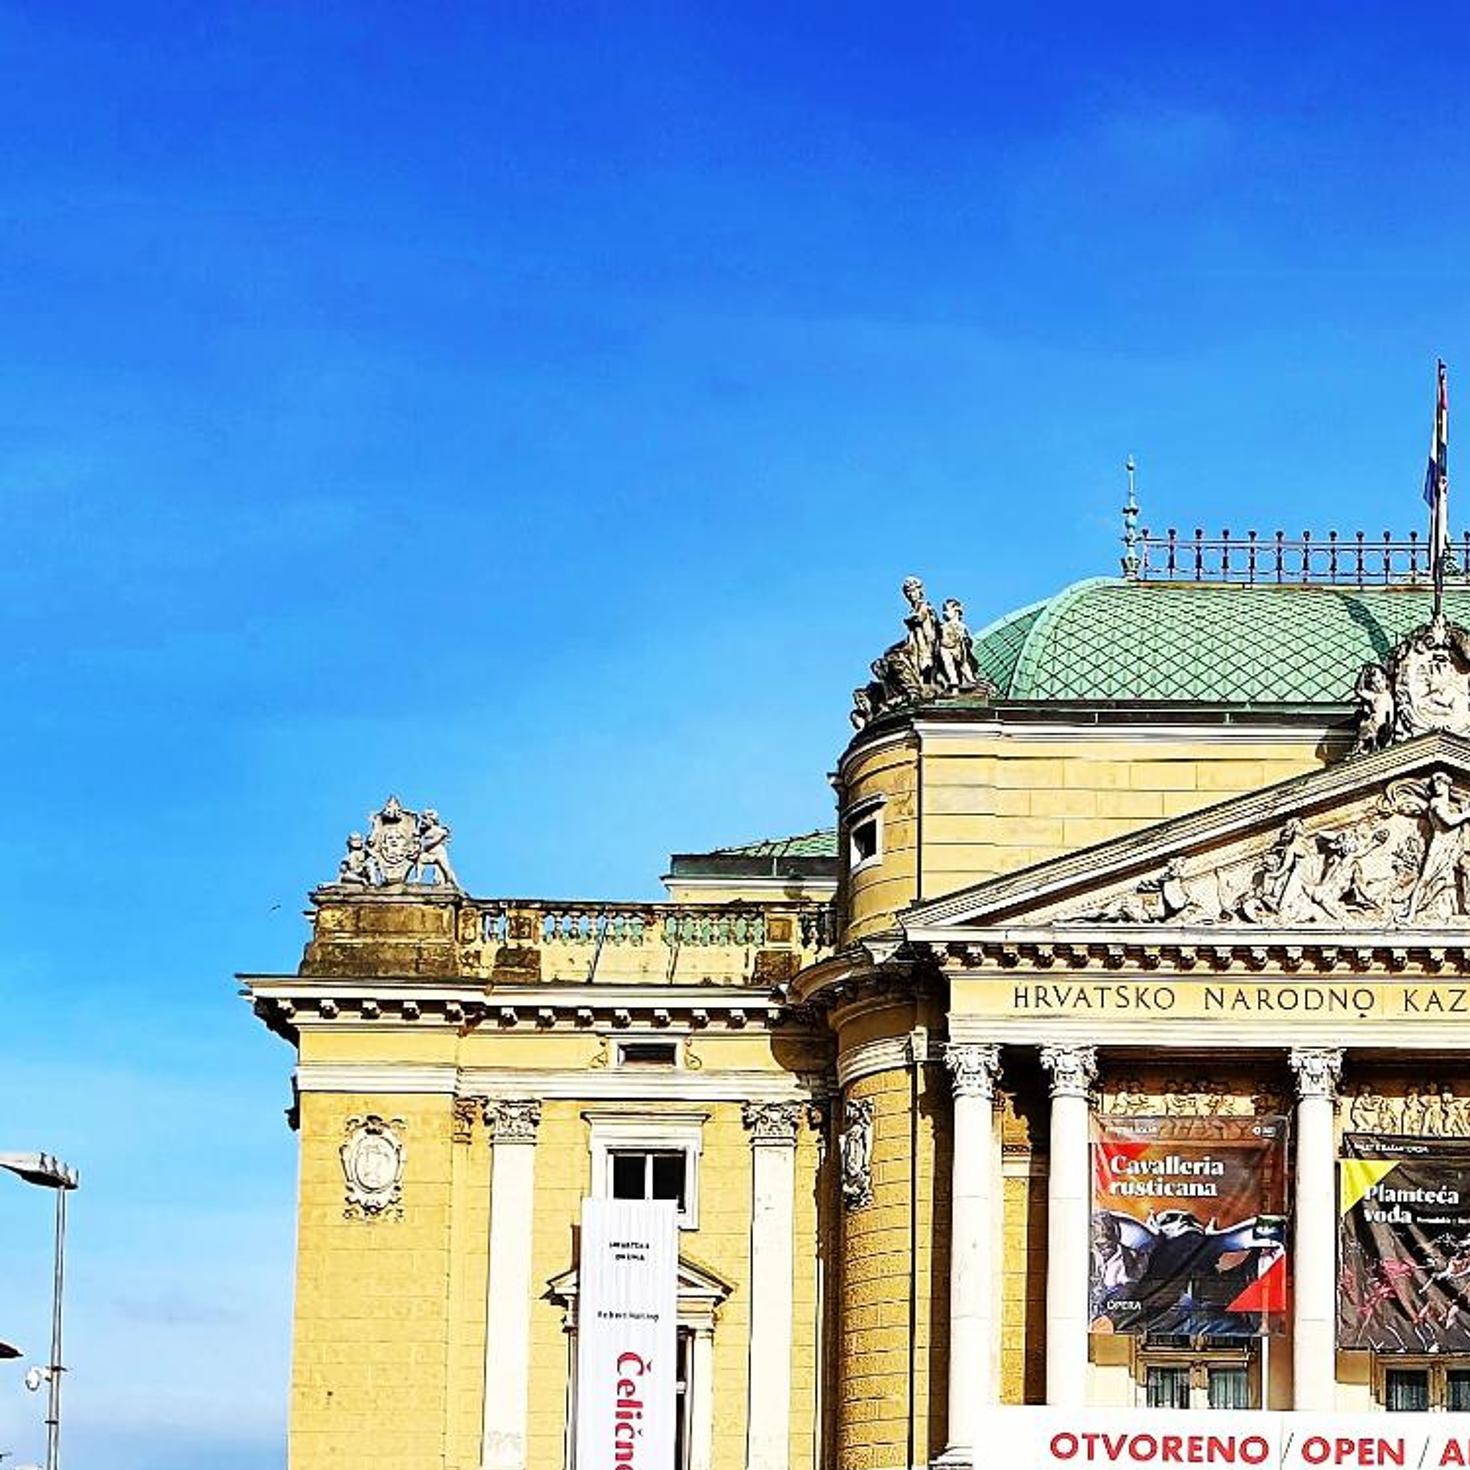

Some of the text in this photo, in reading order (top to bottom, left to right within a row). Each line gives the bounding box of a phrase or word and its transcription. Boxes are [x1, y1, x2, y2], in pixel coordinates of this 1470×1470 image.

[1013, 984, 1176, 1010] HRVATSKO
[1204, 986, 1376, 1012] NARODNO
[1110, 1155, 1225, 1176] Cavalleria
[1109, 1178, 1218, 1196] rusticana
[1365, 1183, 1460, 1205] Plamteća
[1363, 1205, 1413, 1225] voda
[1106, 1300, 1142, 1311] OPERA
[1049, 1431, 1270, 1465] OTVORENO
[1300, 1435, 1406, 1466] OPEN
